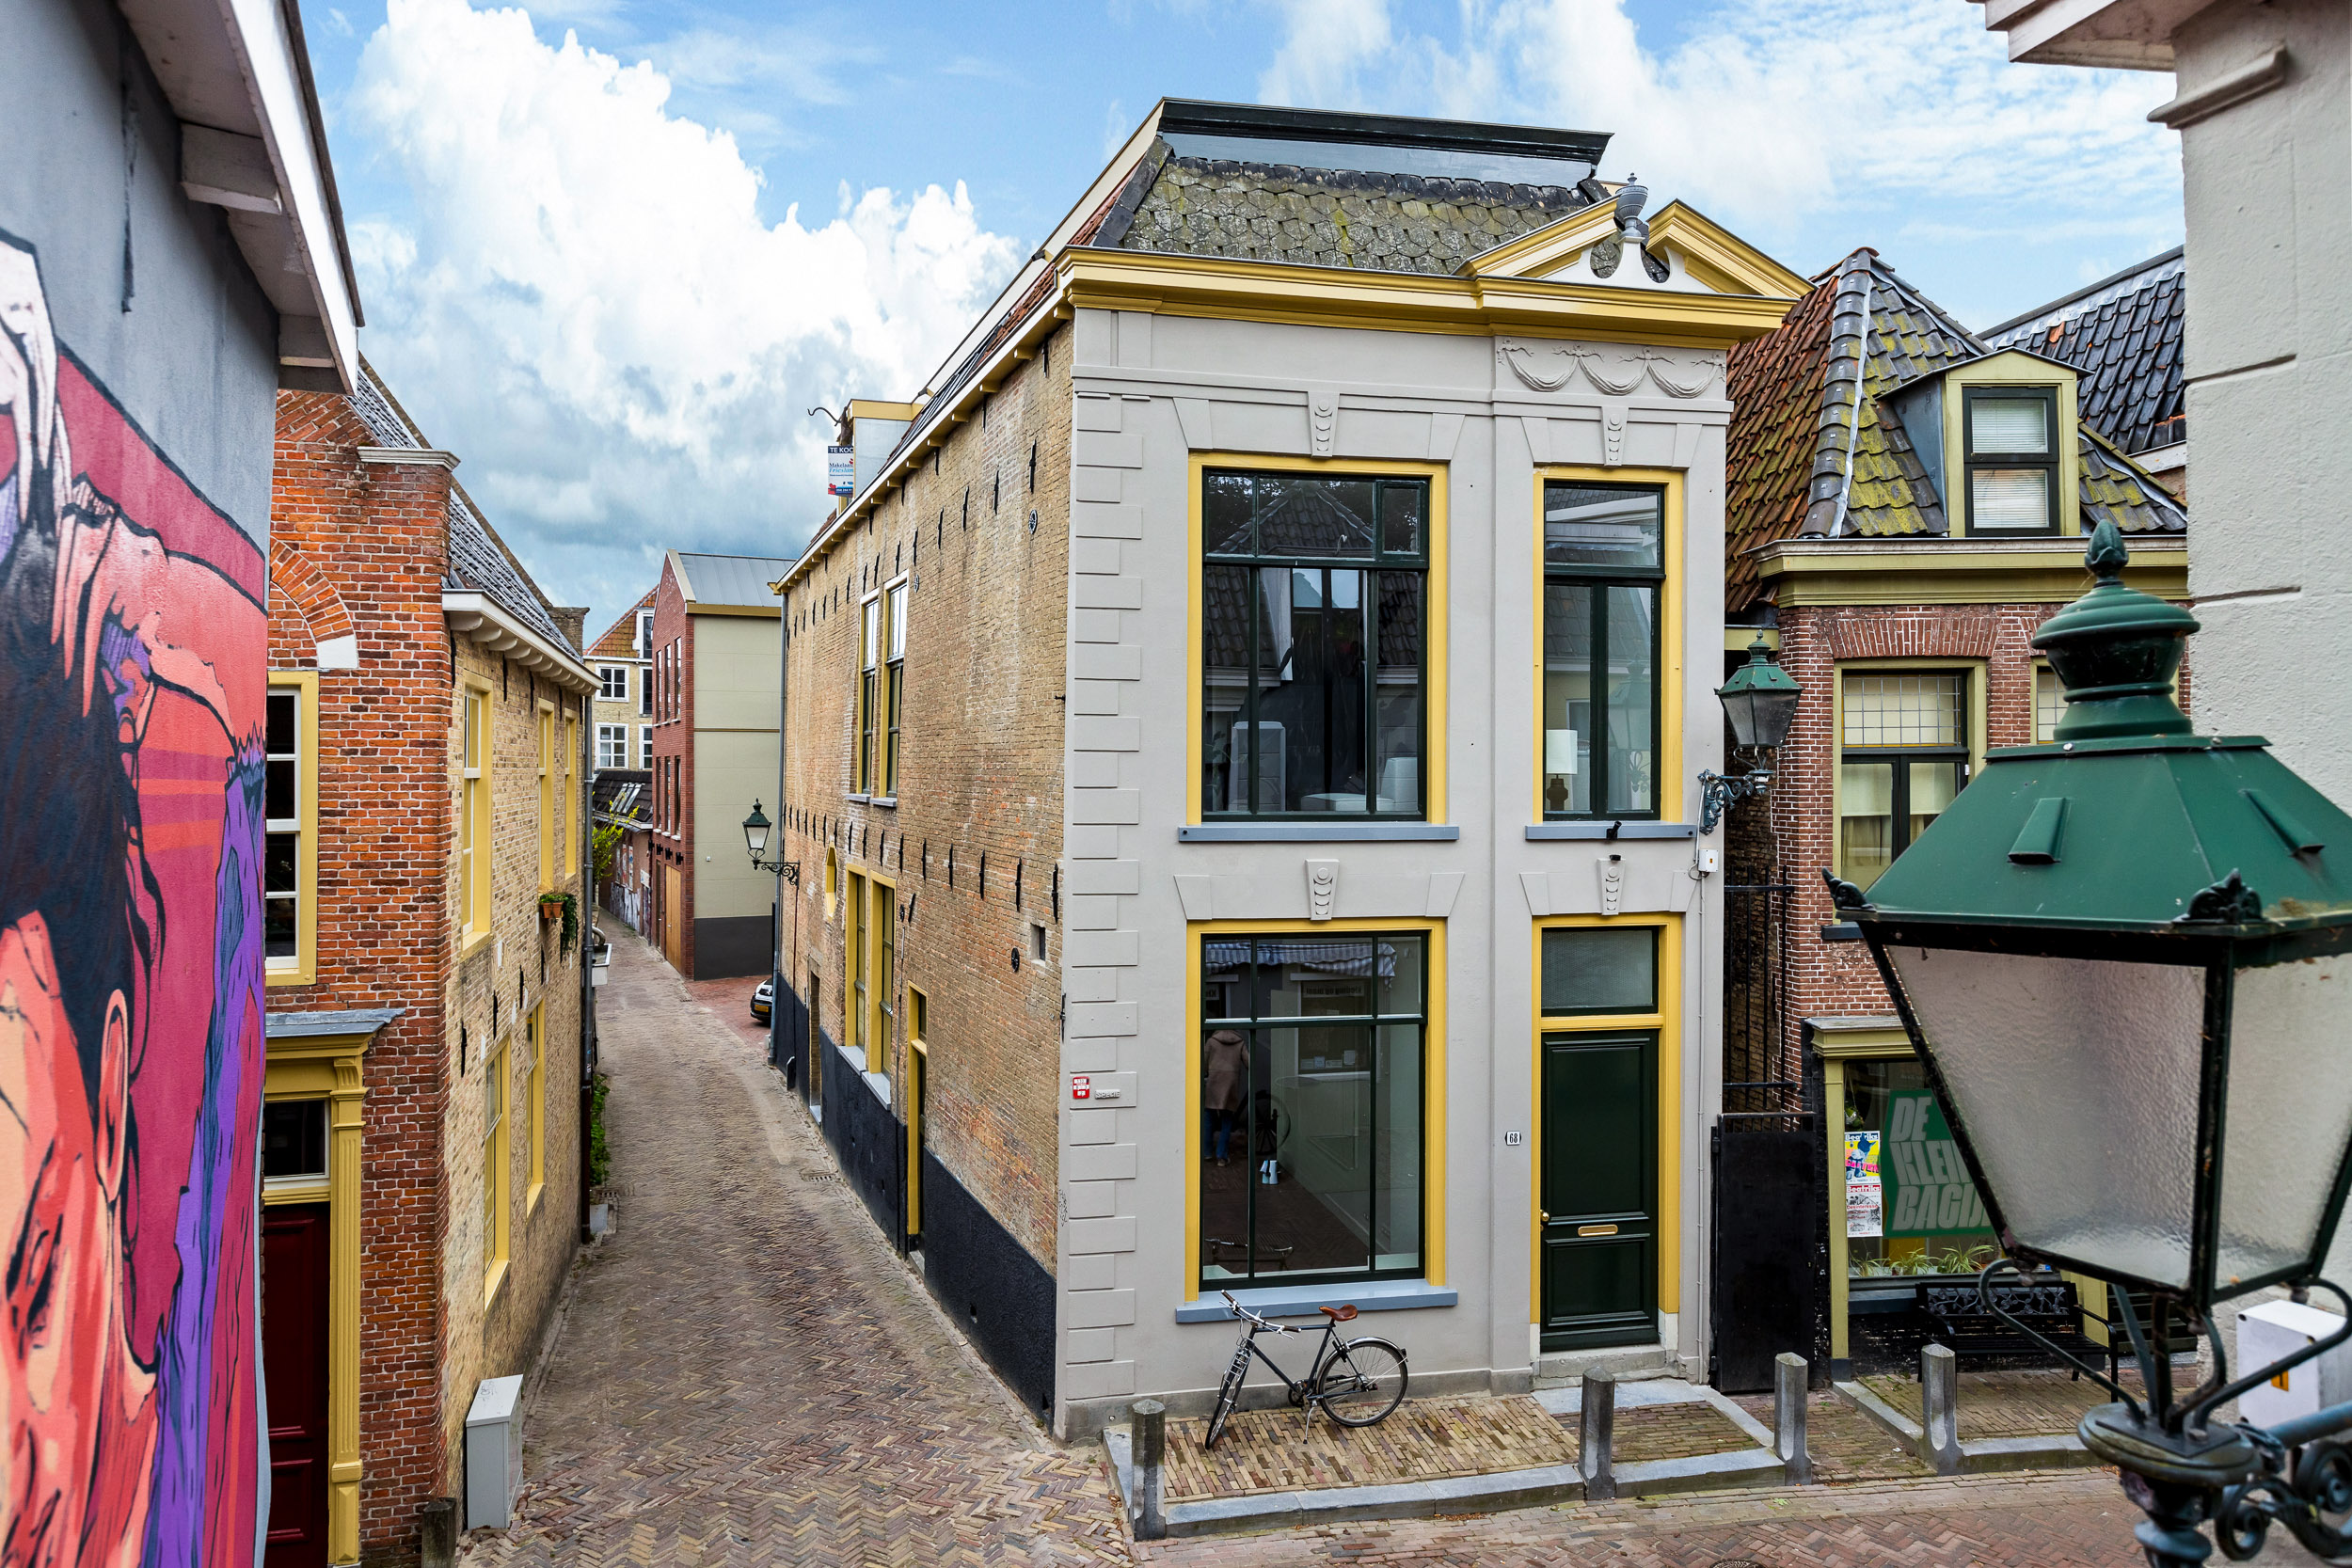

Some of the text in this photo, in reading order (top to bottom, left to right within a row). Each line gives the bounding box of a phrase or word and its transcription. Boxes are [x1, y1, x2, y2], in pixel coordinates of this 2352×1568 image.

[1889, 1097, 1932, 1141] DE
[1510, 1132, 1518, 1143] 68
[1845, 1132, 1879, 1141] Beariks
[1893, 1184, 1992, 1230] BAGIJ
